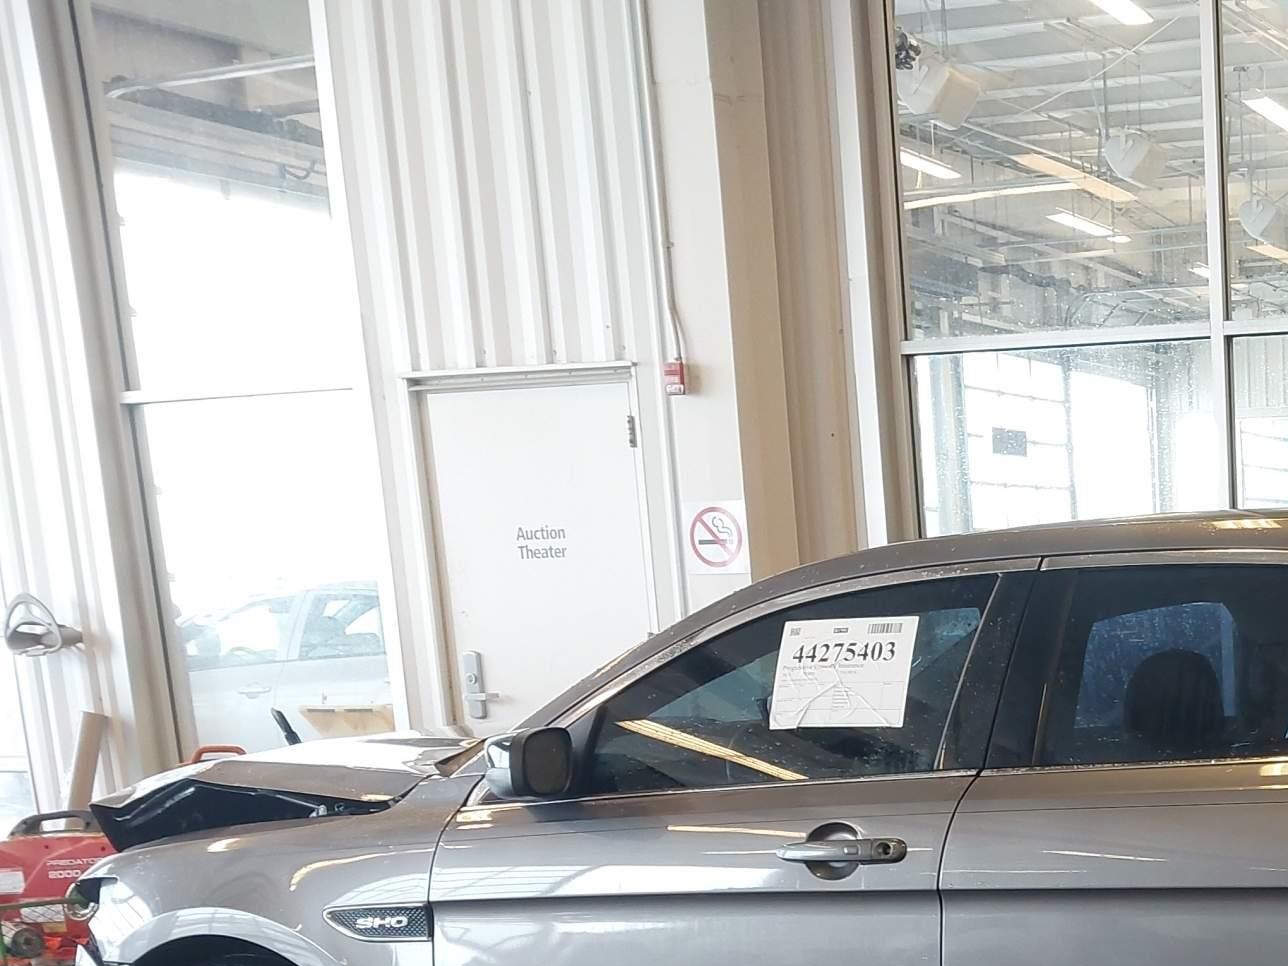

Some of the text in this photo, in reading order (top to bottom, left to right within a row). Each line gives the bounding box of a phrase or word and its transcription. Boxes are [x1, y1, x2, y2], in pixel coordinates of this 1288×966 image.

[516, 524, 566, 541] Auction
[518, 545, 567, 560] Theater
[792, 641, 896, 663] 44275403
[356, 916, 409, 929] SHO
